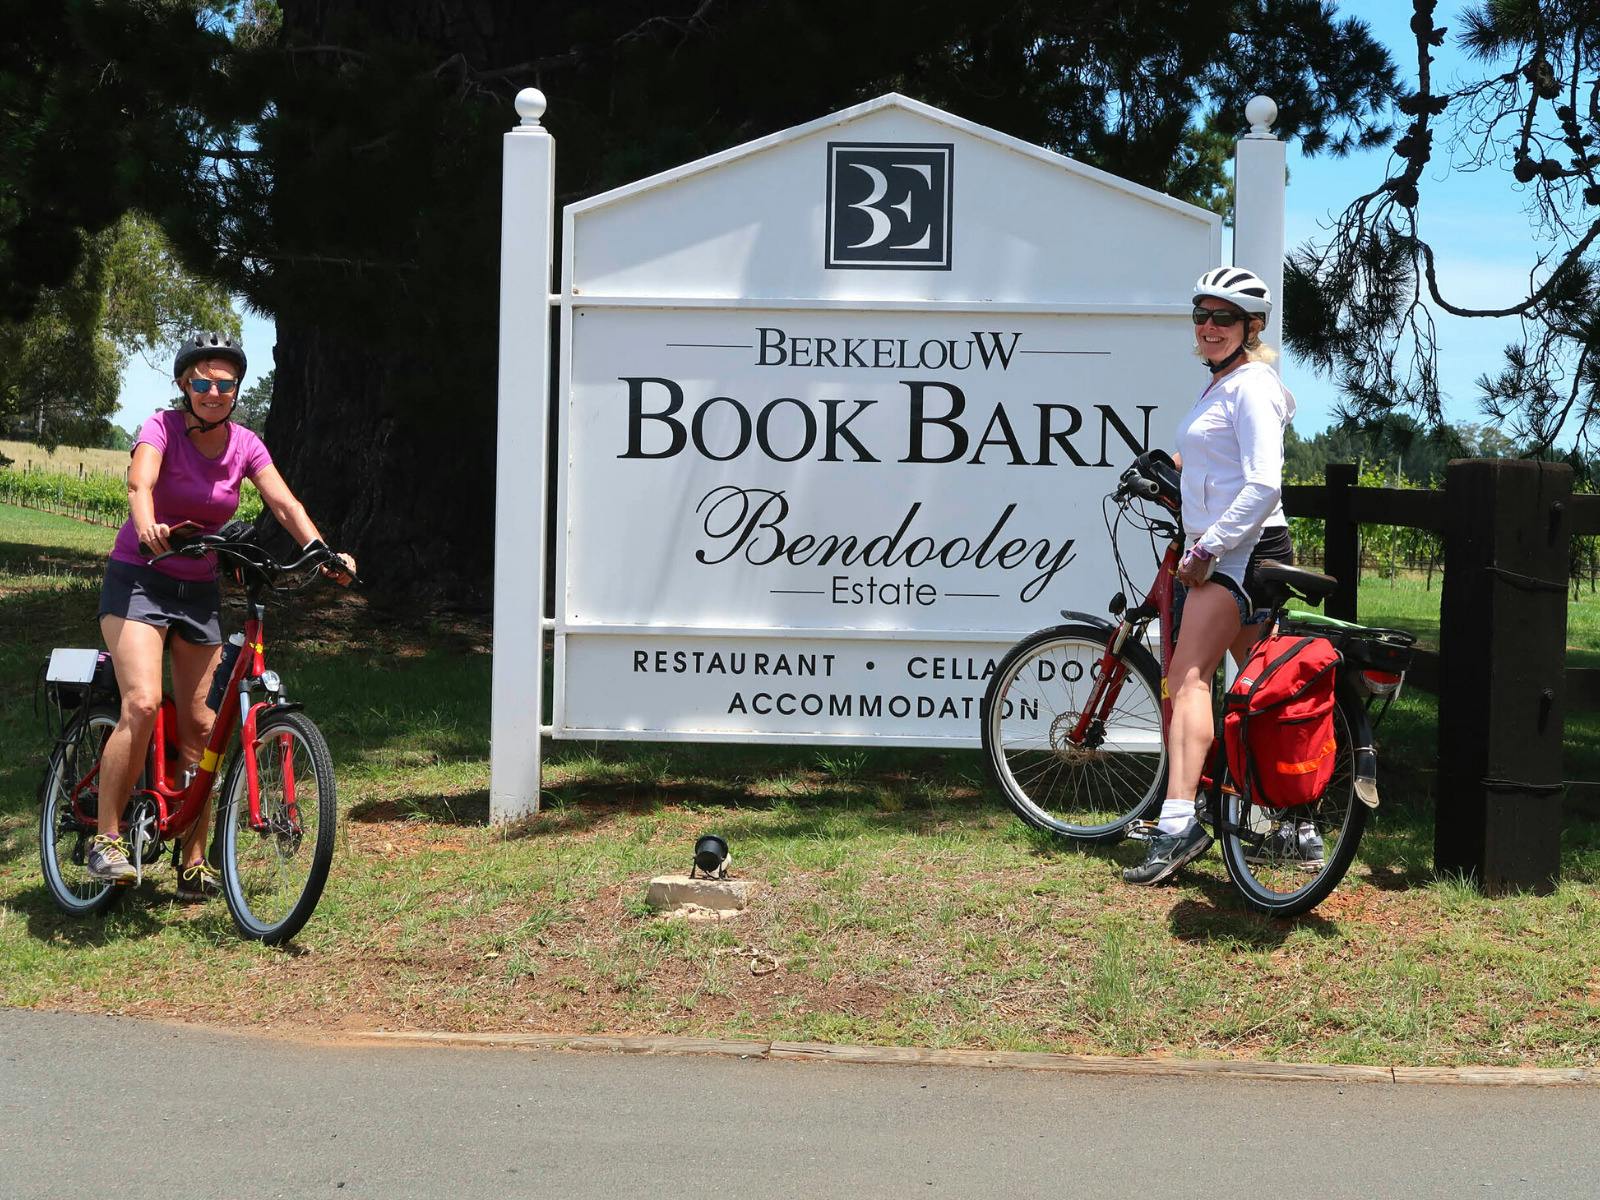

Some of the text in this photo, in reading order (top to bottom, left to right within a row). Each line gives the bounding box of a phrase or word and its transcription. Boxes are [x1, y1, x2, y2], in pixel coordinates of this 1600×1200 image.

[755, 327, 1023, 371] BERKELOUW
[616, 376, 1159, 467] BOOK BARN
[695, 485, 1077, 603] Bendooley
[832, 575, 938, 606] Estate
[633, 650, 1134, 684] RESTAURANT CELLA DO
